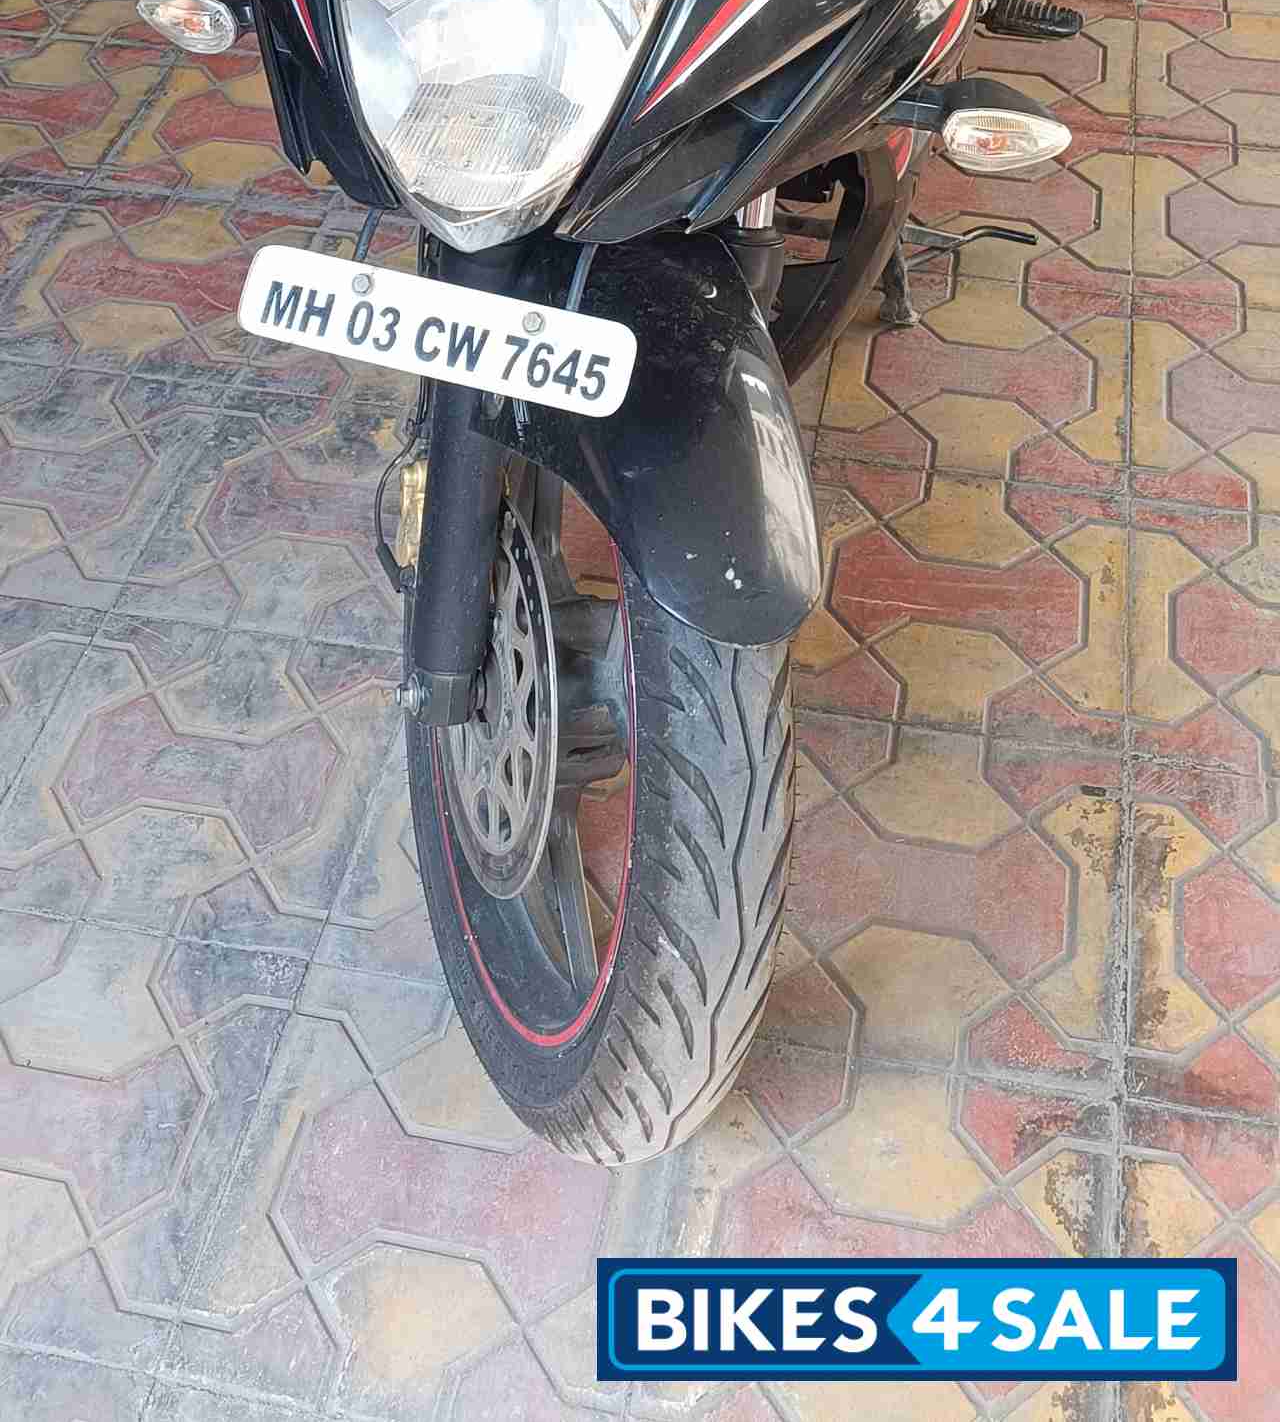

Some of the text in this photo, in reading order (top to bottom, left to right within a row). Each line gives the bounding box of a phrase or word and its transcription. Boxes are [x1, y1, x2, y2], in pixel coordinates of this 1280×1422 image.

[260, 280, 611, 401] MH 03 CW 7645
